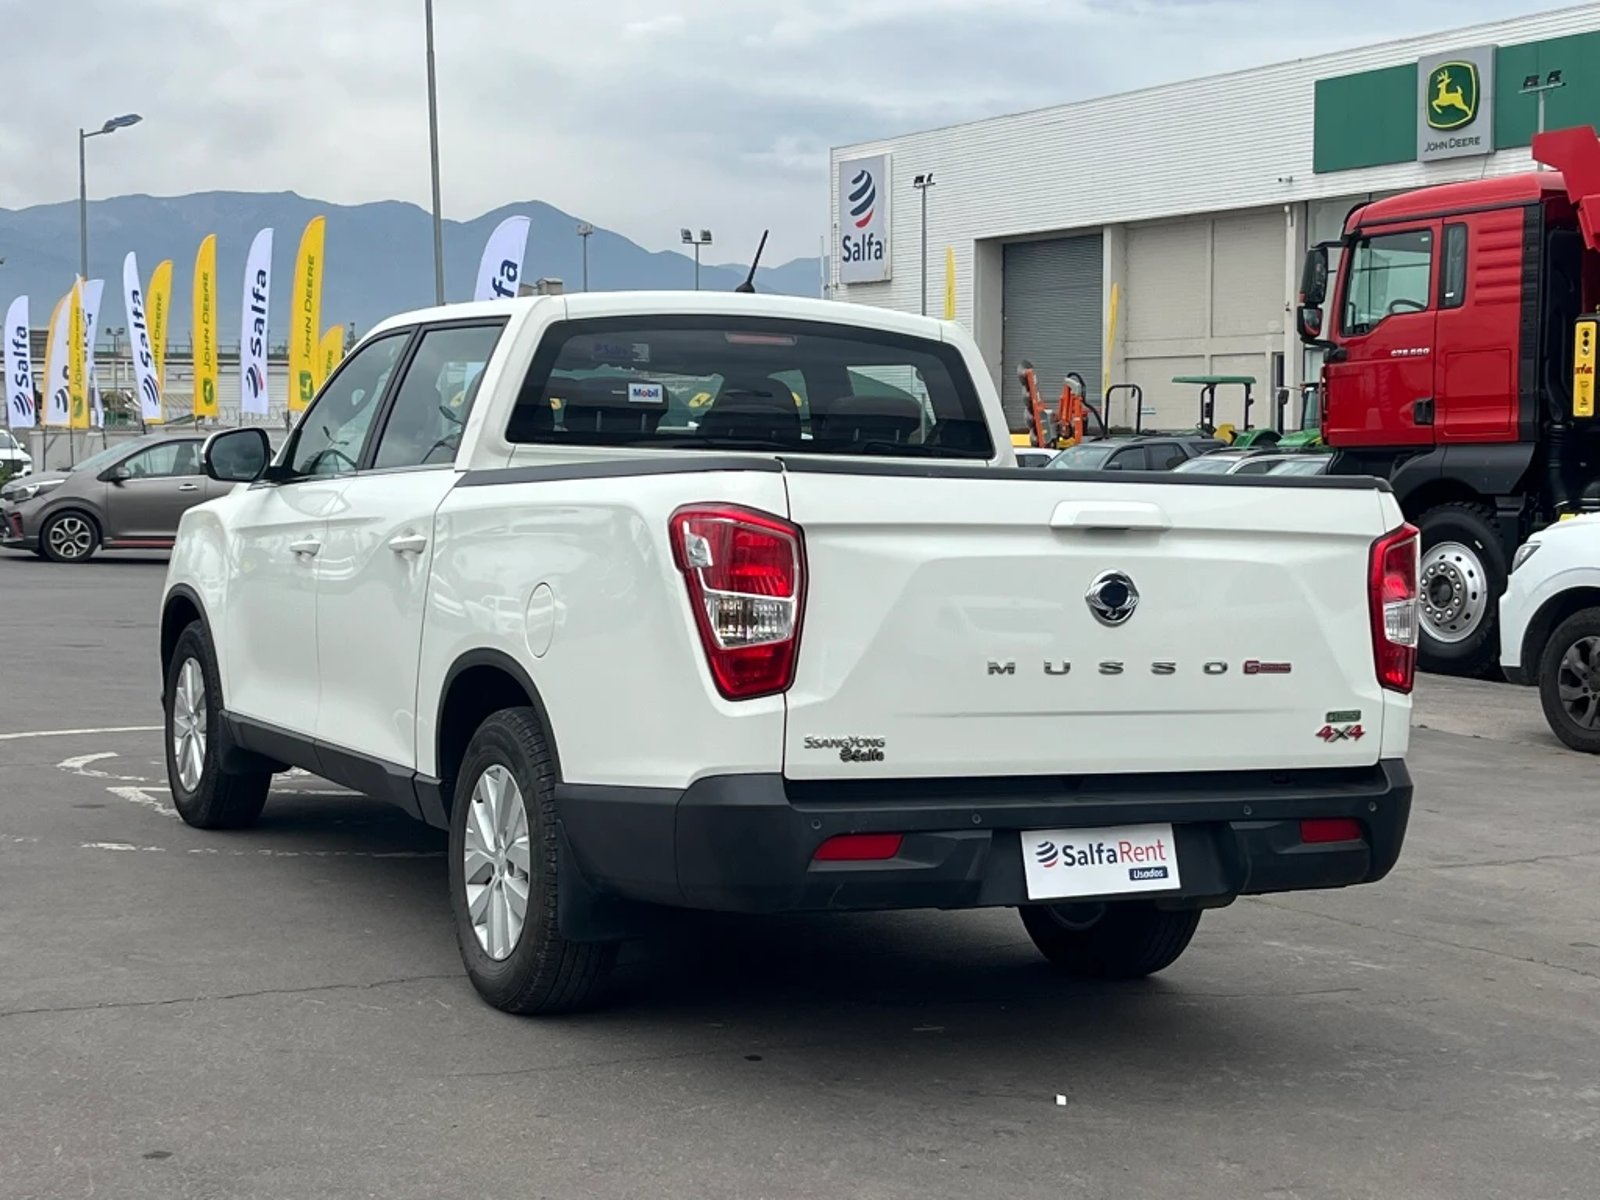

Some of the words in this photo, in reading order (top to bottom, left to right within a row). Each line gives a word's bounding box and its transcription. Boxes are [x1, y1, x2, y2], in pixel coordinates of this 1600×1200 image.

[1424, 141, 1448, 153] JOHN
[1449, 136, 1481, 149] DEERE
[842, 232, 883, 263] Salfa
[304, 254, 315, 314] DEERE
[131, 289, 153, 368] Salfa
[250, 269, 267, 359] Salfa
[12, 325, 29, 388] Salfa
[202, 328, 211, 372] JOHN
[303, 318, 313, 364] JOHN
[632, 388, 659, 398] Mobil
[987, 660, 1229, 676] MUSSO
[1062, 839, 1167, 867] SalfaRent
[1133, 868, 1164, 880] Usados
